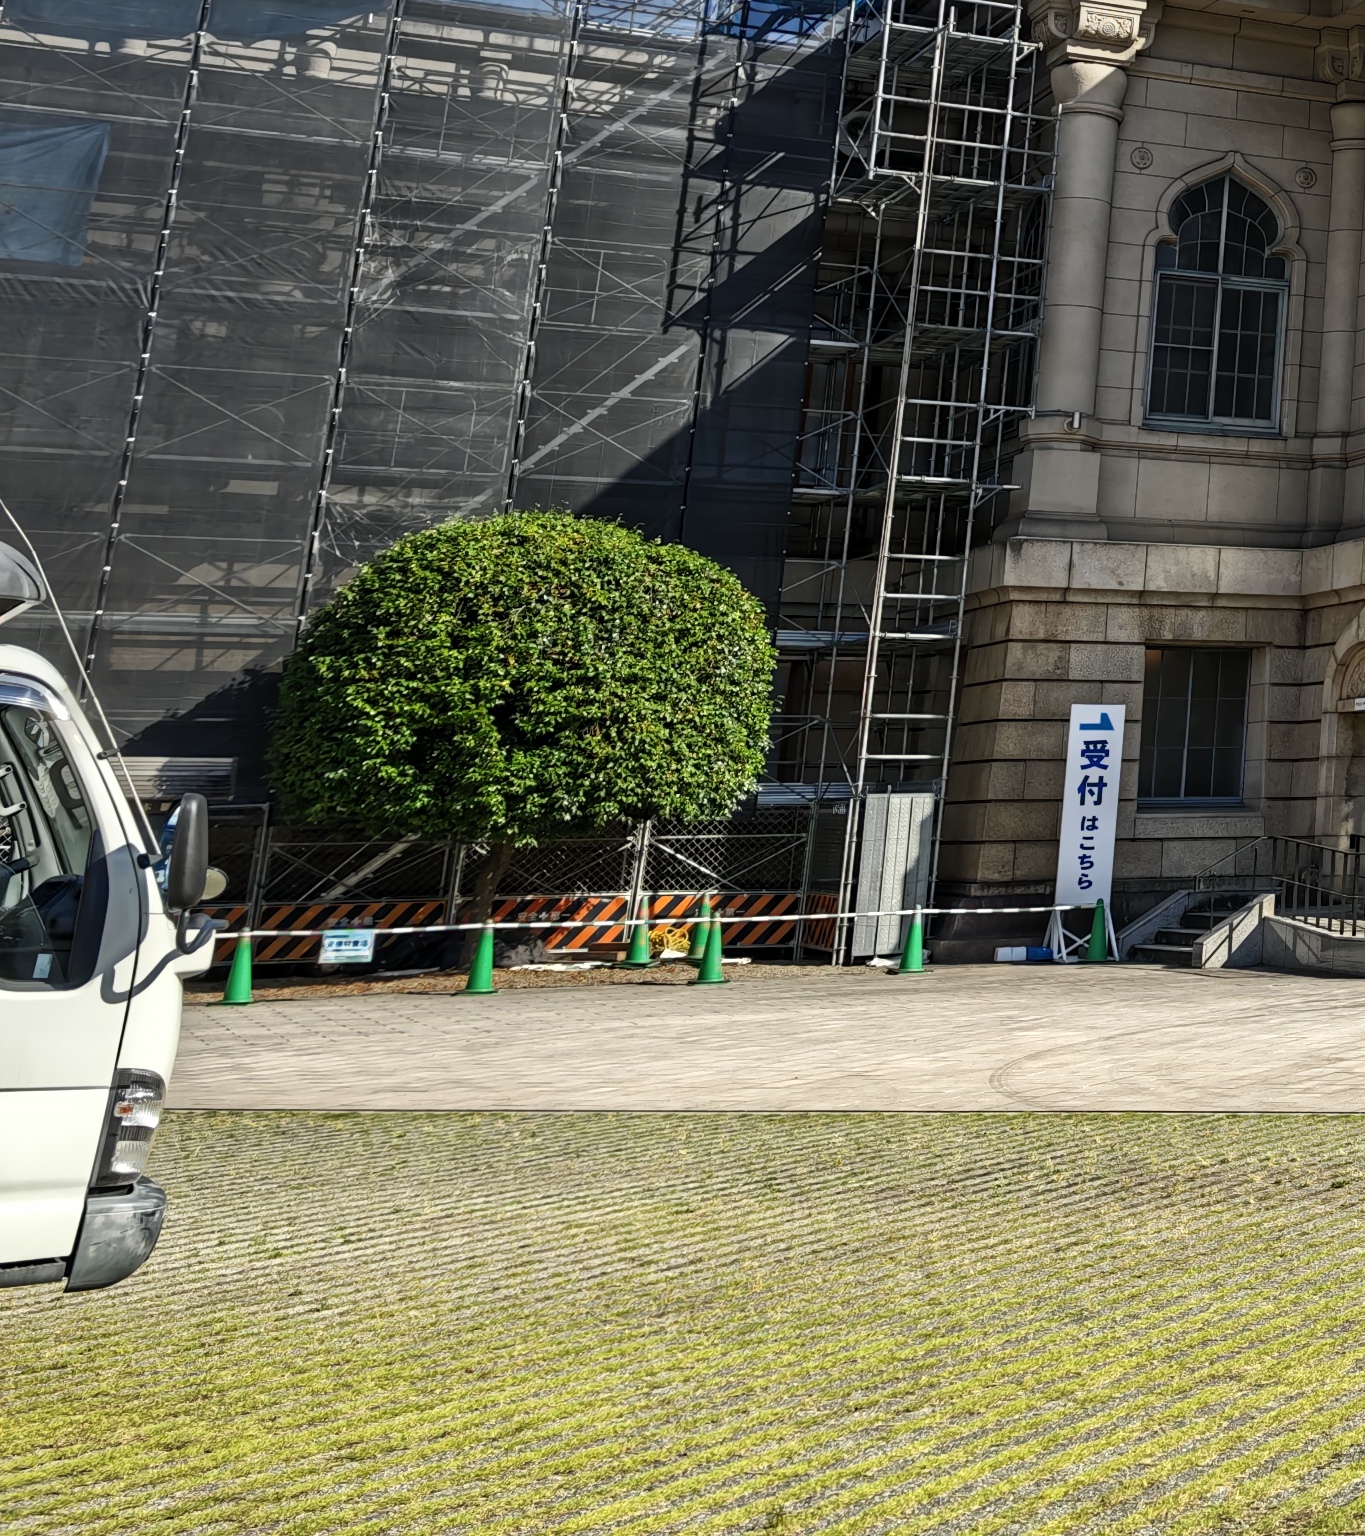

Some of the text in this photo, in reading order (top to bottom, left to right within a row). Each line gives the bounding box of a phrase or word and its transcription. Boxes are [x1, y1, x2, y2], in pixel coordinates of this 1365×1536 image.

[1077, 740, 1109, 890] 受付はこちら
